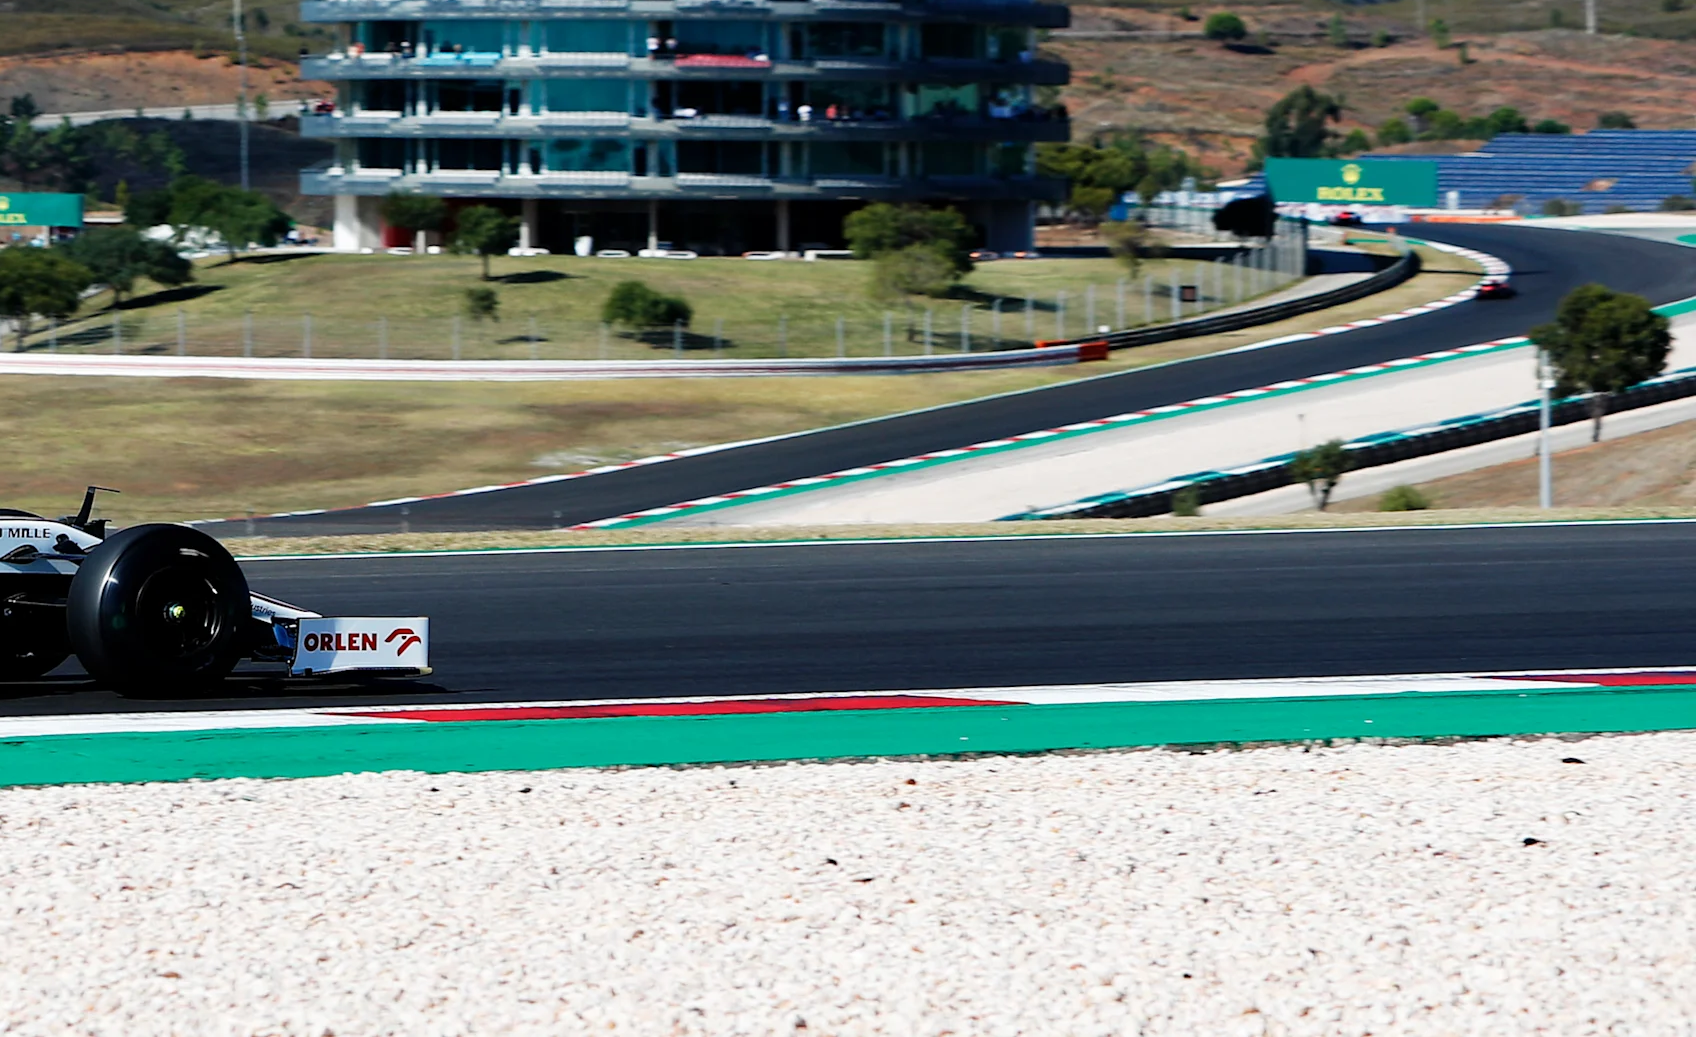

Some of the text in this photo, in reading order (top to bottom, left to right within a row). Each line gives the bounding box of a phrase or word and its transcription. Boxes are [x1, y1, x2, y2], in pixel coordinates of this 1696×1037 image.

[1316, 186, 1385, 201] ROLEX
[8, 528, 51, 539] MILLE
[304, 633, 377, 652] ORLEN
